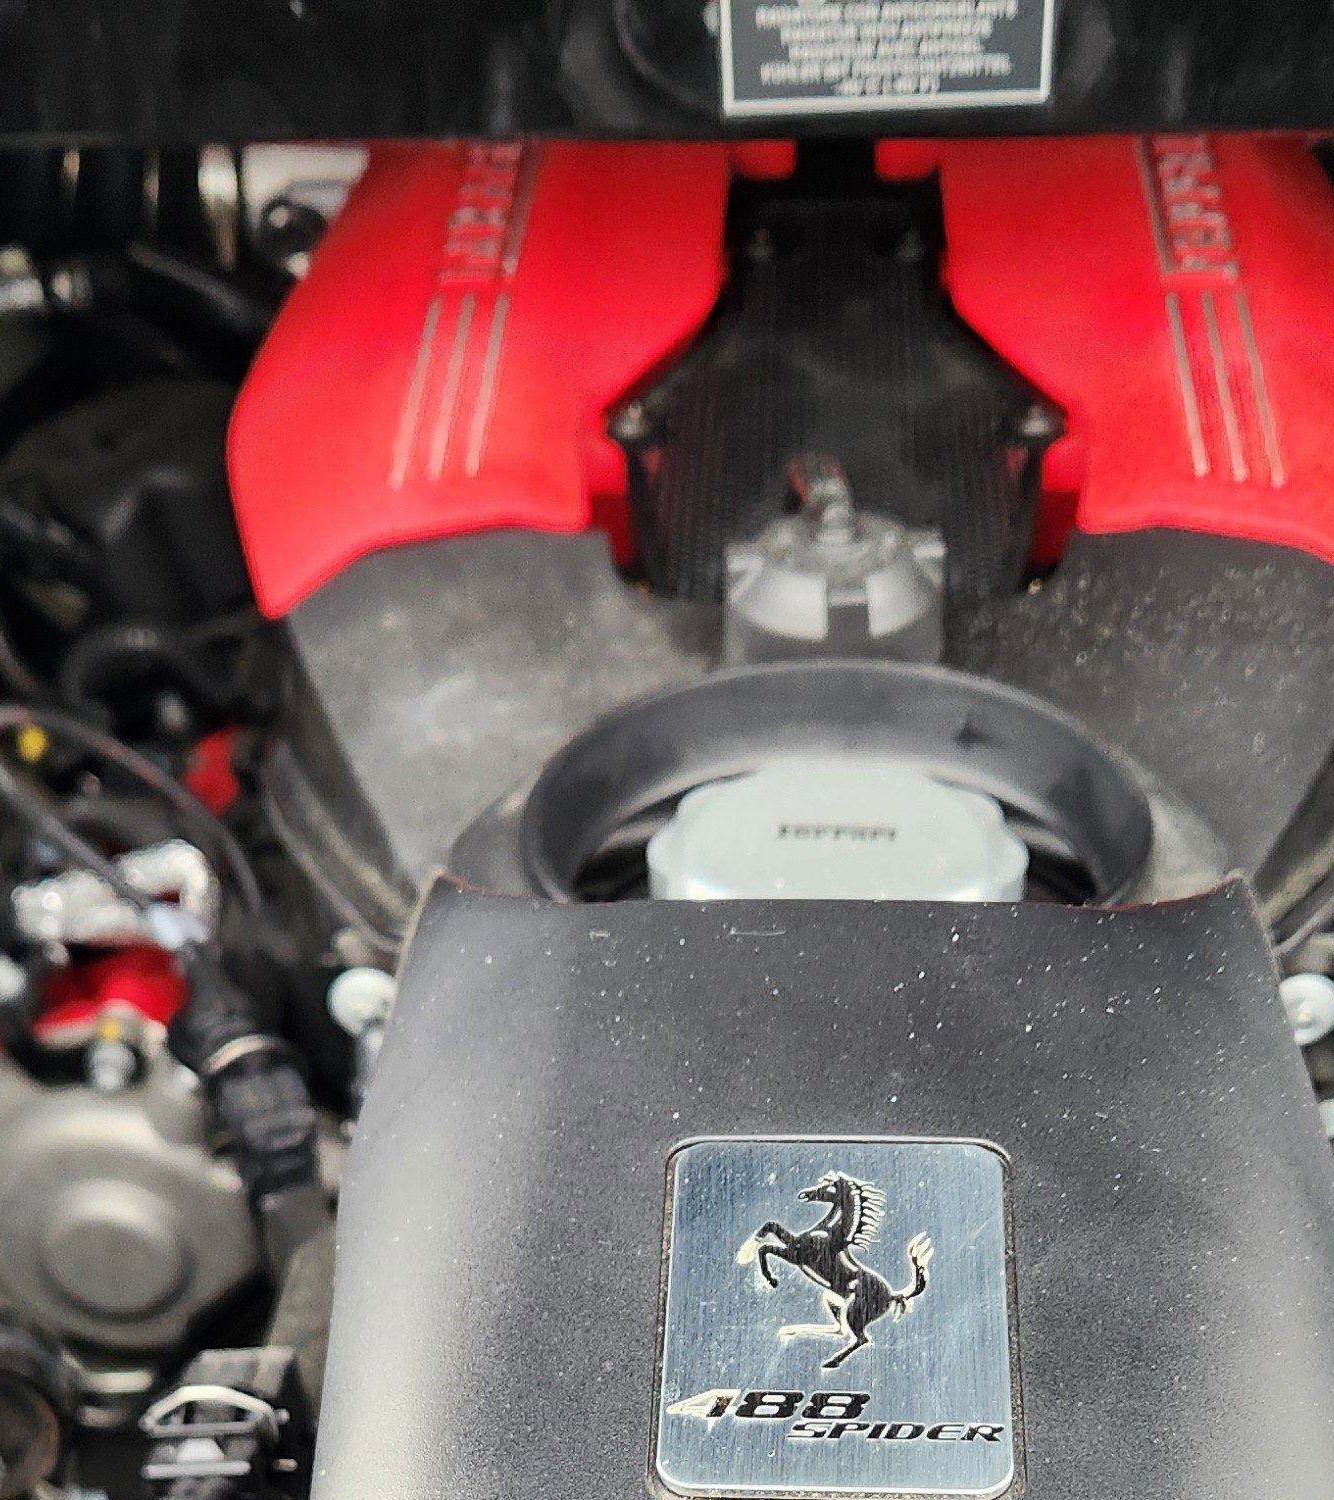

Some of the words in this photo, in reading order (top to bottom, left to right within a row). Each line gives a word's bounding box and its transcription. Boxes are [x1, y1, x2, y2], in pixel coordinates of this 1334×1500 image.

[777, 823, 897, 841] Ferrari
[667, 1388, 871, 1419] 488
[787, 1421, 1005, 1442] SPIDER
